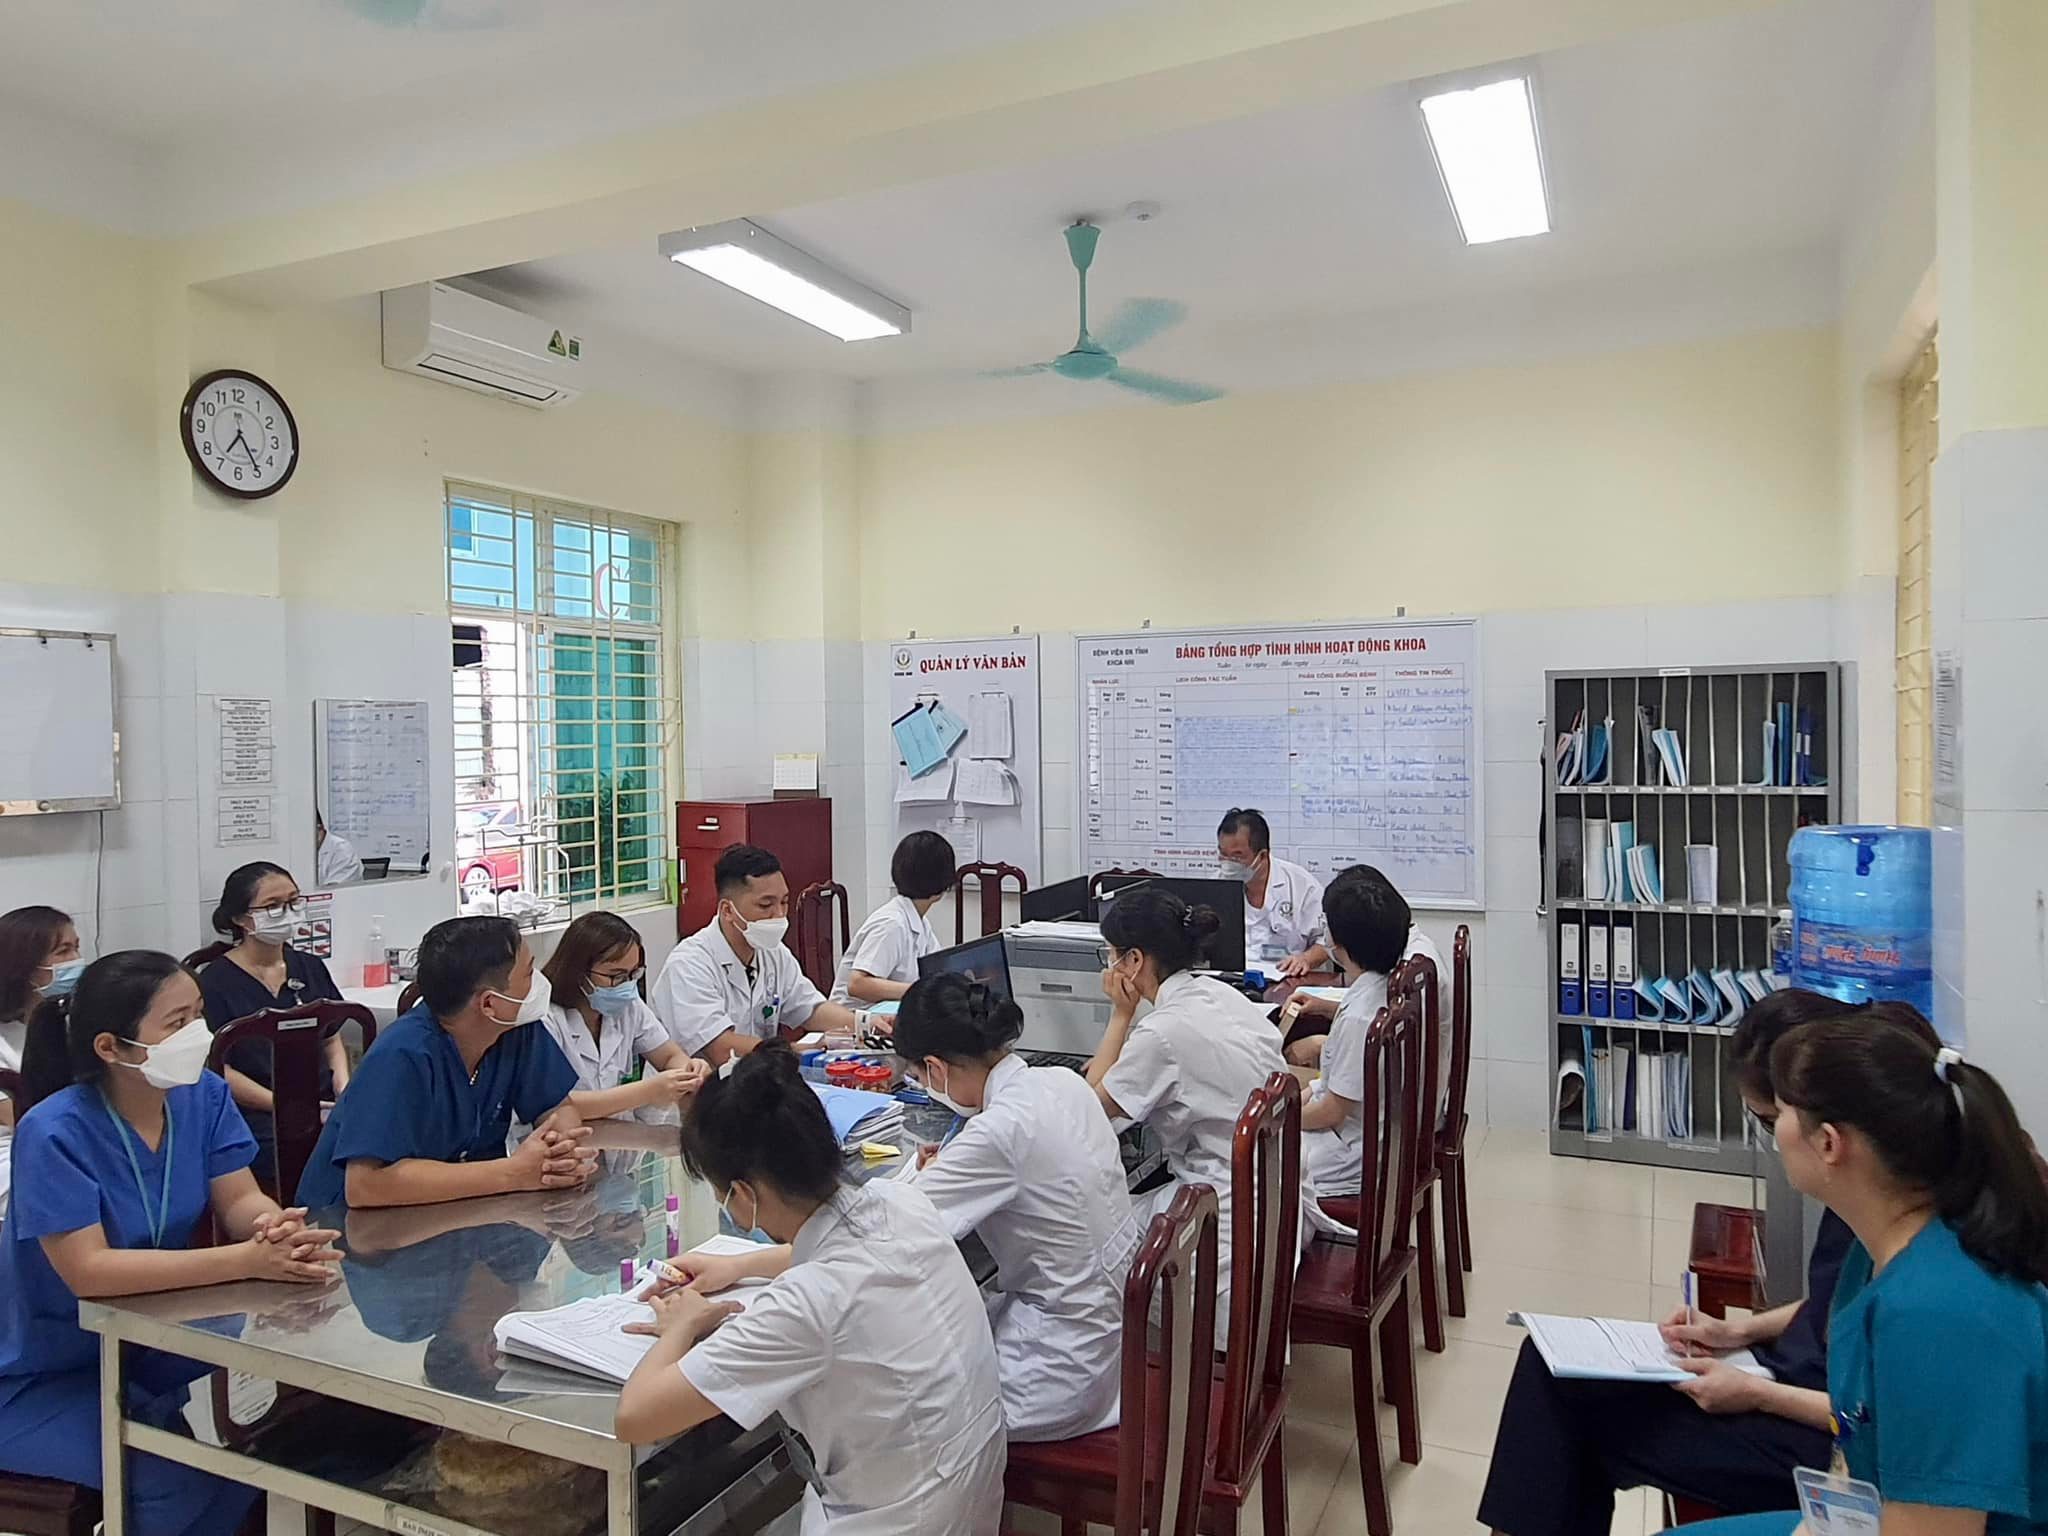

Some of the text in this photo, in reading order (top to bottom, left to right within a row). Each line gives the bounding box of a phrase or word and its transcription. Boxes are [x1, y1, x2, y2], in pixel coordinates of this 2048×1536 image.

[216, 389, 226, 405] 11
[231, 388, 245, 404] 12
[200, 401, 216, 417] 10
[255, 399, 260, 413] 1
[196, 418, 206, 433] 9
[265, 415, 274, 430] 2
[202, 440, 212, 456] 8
[270, 435, 279, 450] 3
[216, 456, 225, 470] 7
[265, 455, 274, 467] 4
[233, 466, 243, 481] 6
[252, 464, 262, 479] 5
[1175, 638, 1426, 659] BẢNG TỔNG HỢP TÌNH HÌNH HOẠT ĐỘNG KHOA
[919, 651, 1026, 673] QUẢN LÝ VĂN BẢN
